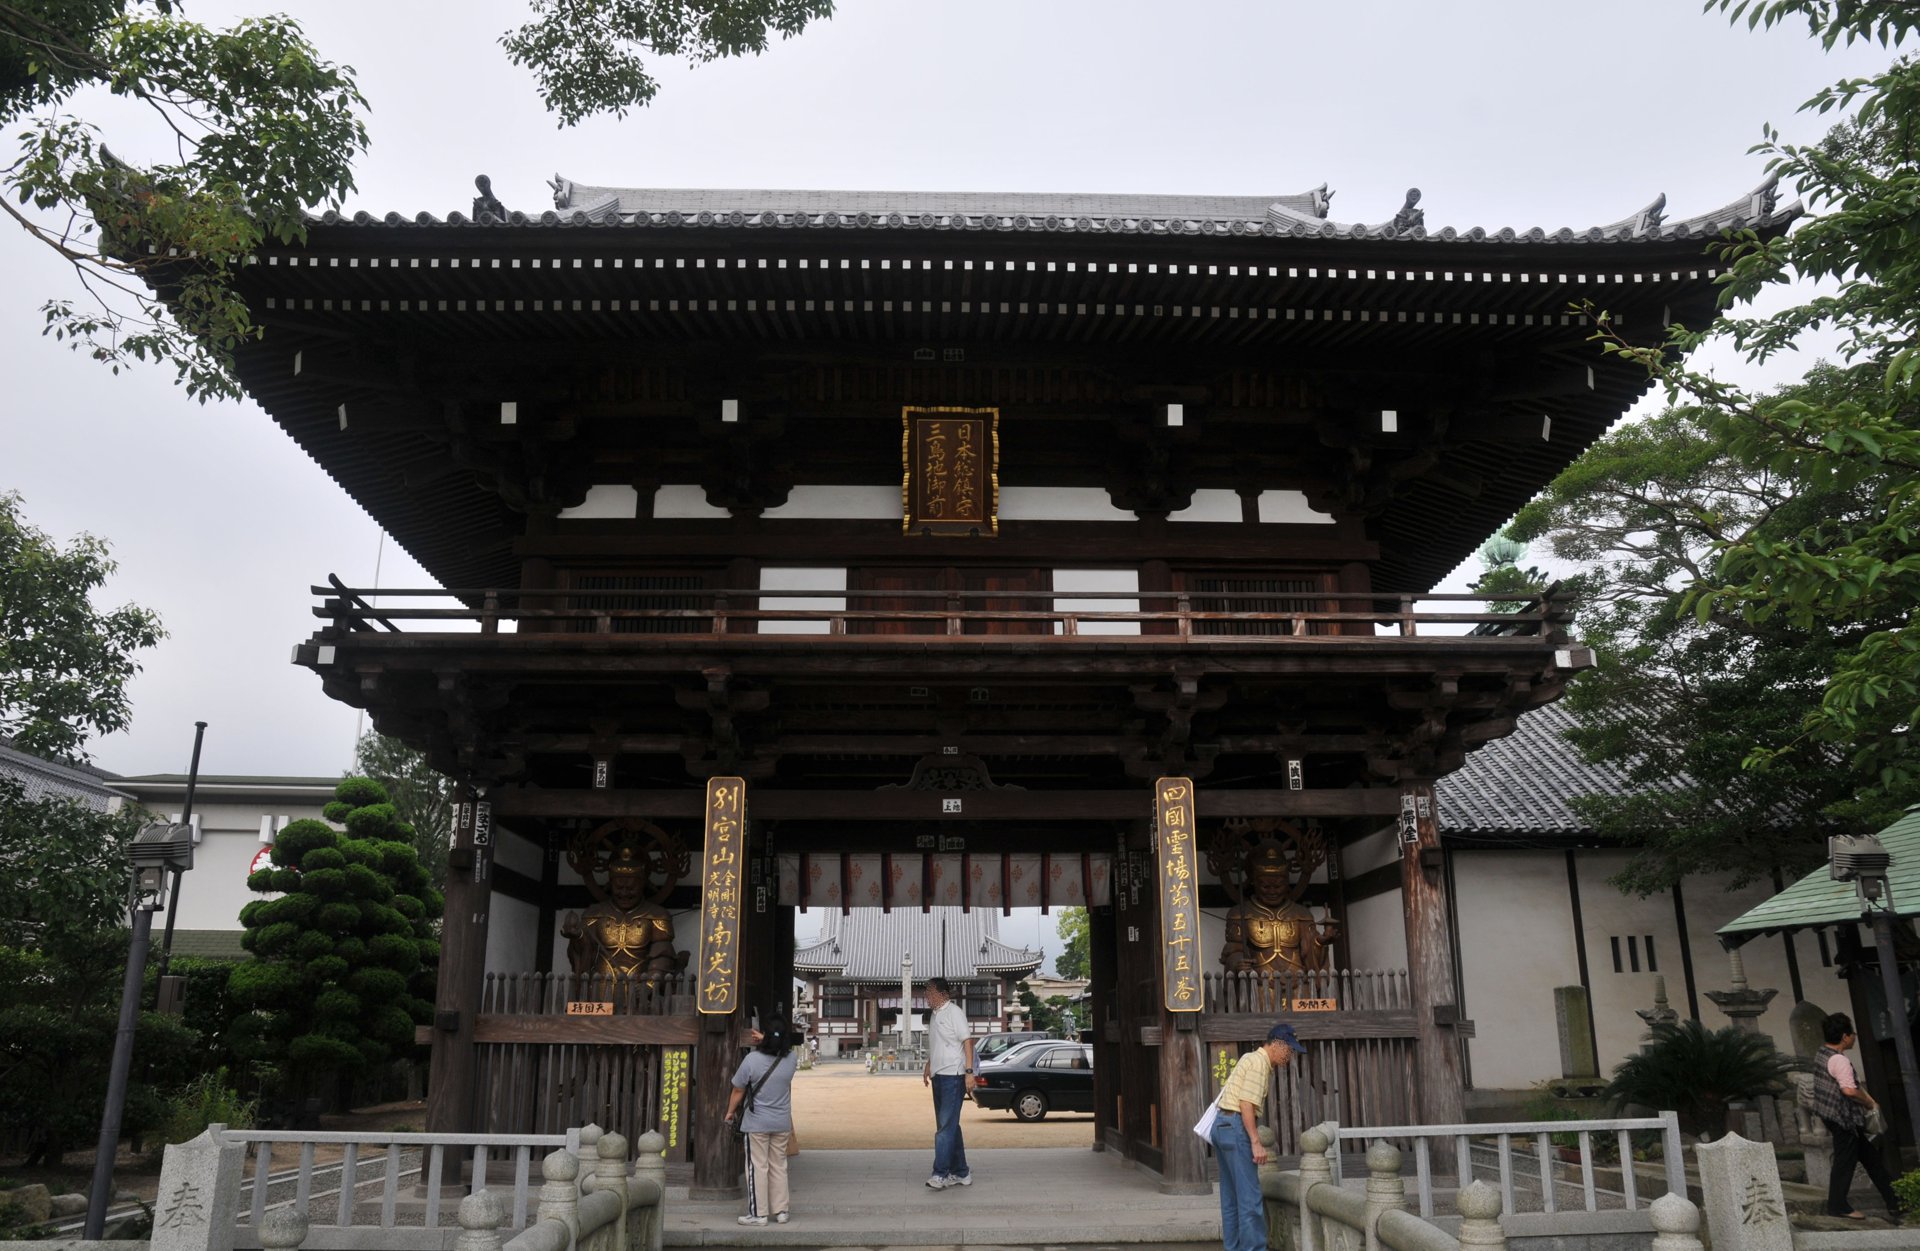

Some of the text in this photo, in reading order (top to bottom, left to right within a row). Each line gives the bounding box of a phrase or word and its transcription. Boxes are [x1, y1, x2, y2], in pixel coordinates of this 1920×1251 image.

[925, 423, 948, 518] 三島地御前
[712, 786, 738, 865] 別宮山
[707, 871, 721, 919] 光明寺
[721, 870, 736, 919] 金剛院
[704, 921, 732, 1003] 南光坊
[160, 1181, 207, 1230] 奉
[1741, 1176, 1785, 1226] 奉
